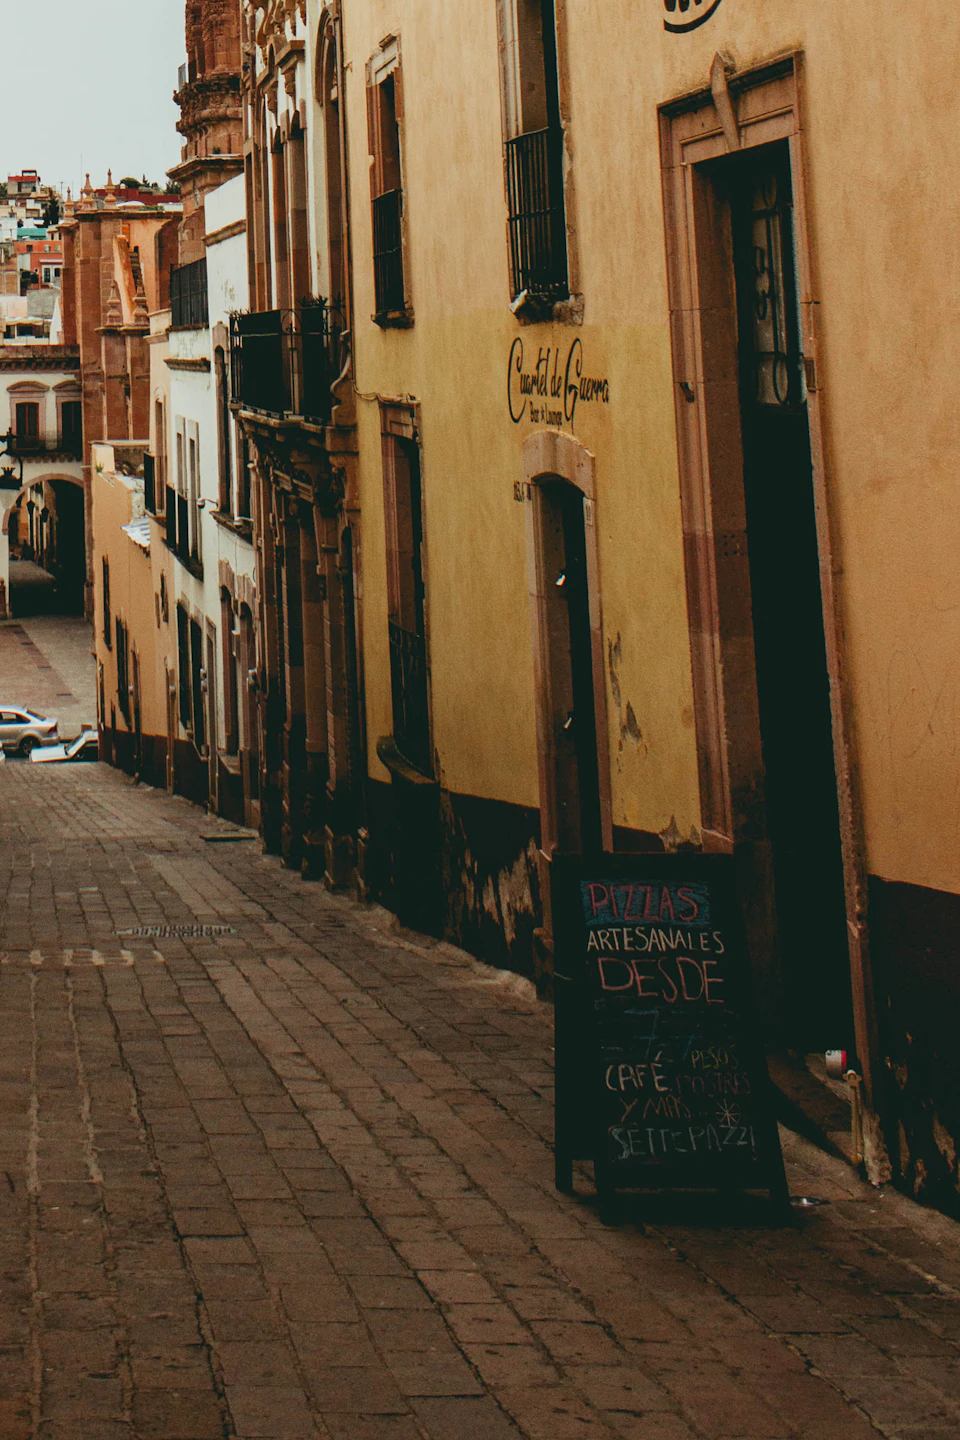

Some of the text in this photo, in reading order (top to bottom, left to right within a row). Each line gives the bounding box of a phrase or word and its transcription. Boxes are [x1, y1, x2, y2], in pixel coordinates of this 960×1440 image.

[507, 337, 609, 436] Cuartel de Guerra
[587, 882, 700, 923] PIZZAS
[587, 926, 725, 954] ARTESANALES
[597, 956, 725, 1004] DESDE
[618, 1097, 639, 1123] Y
